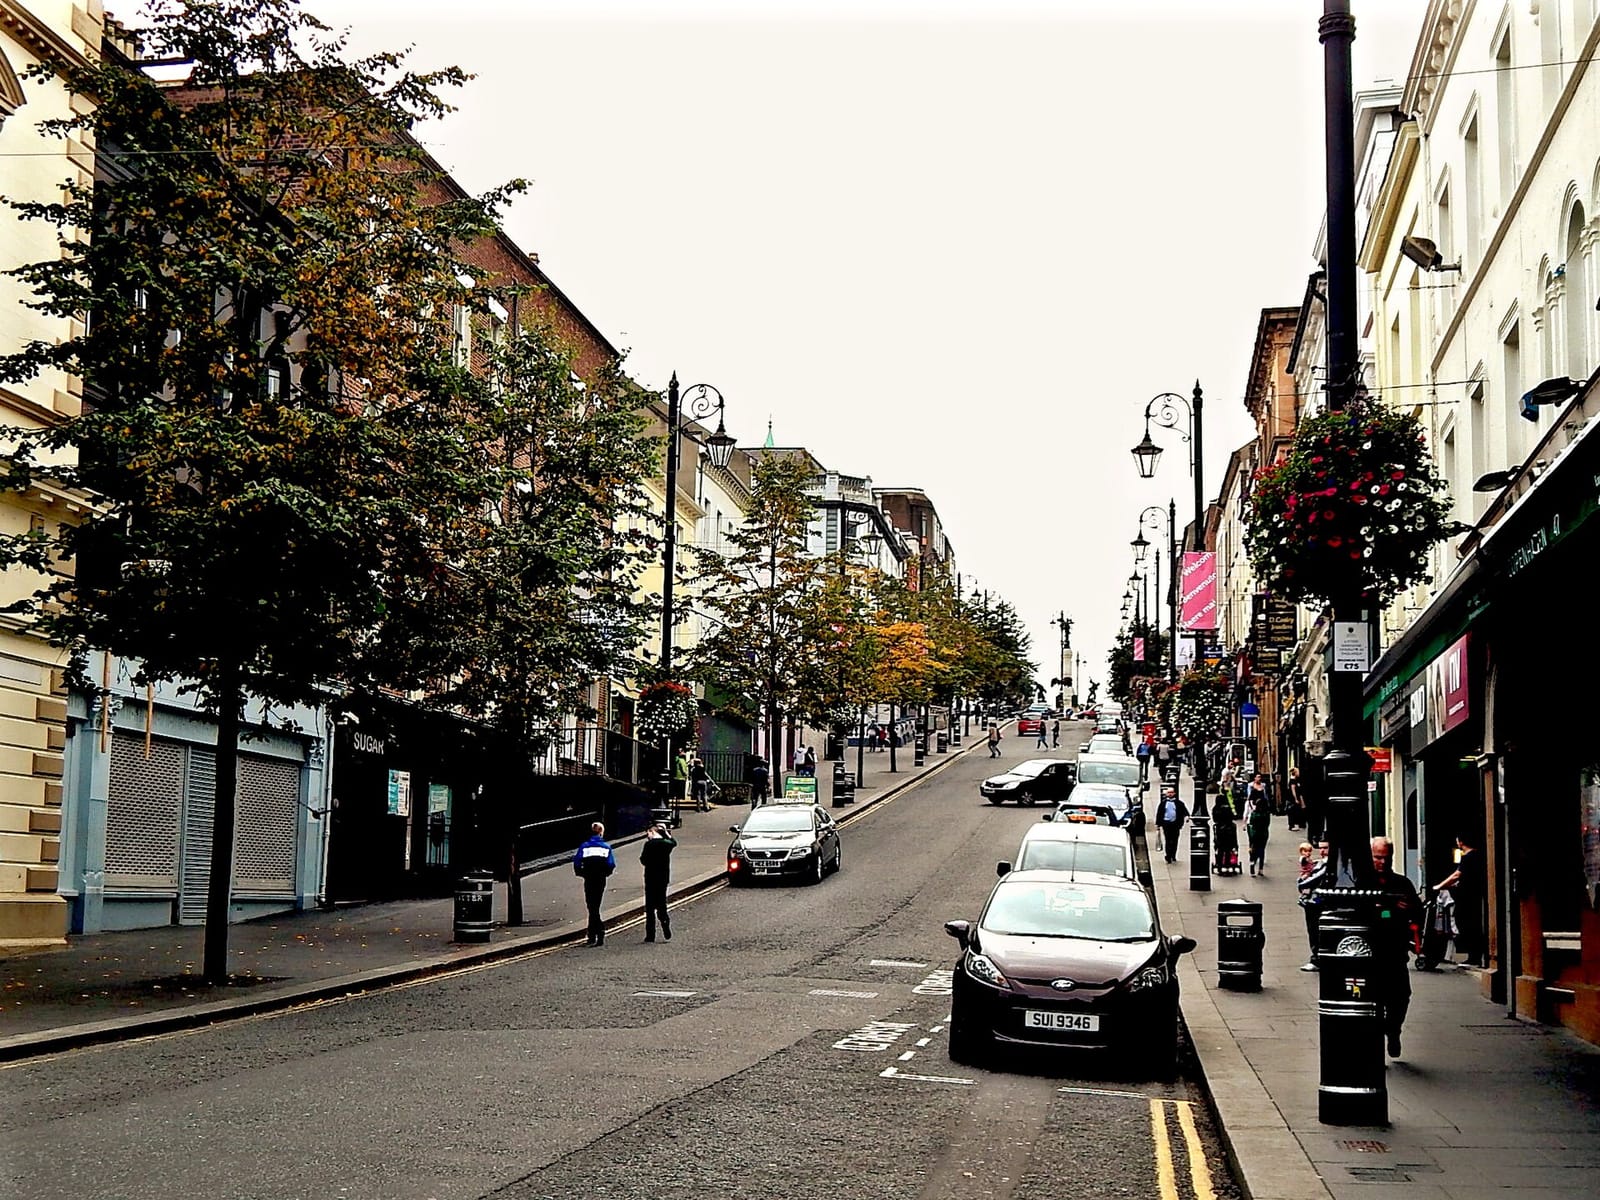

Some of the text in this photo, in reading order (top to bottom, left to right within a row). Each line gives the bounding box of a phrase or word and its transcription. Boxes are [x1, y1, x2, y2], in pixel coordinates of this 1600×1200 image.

[1183, 552, 1213, 577] Welcom
[353, 732, 385, 755] SUGAR
[1033, 1012, 1091, 1029] SUI 9346
